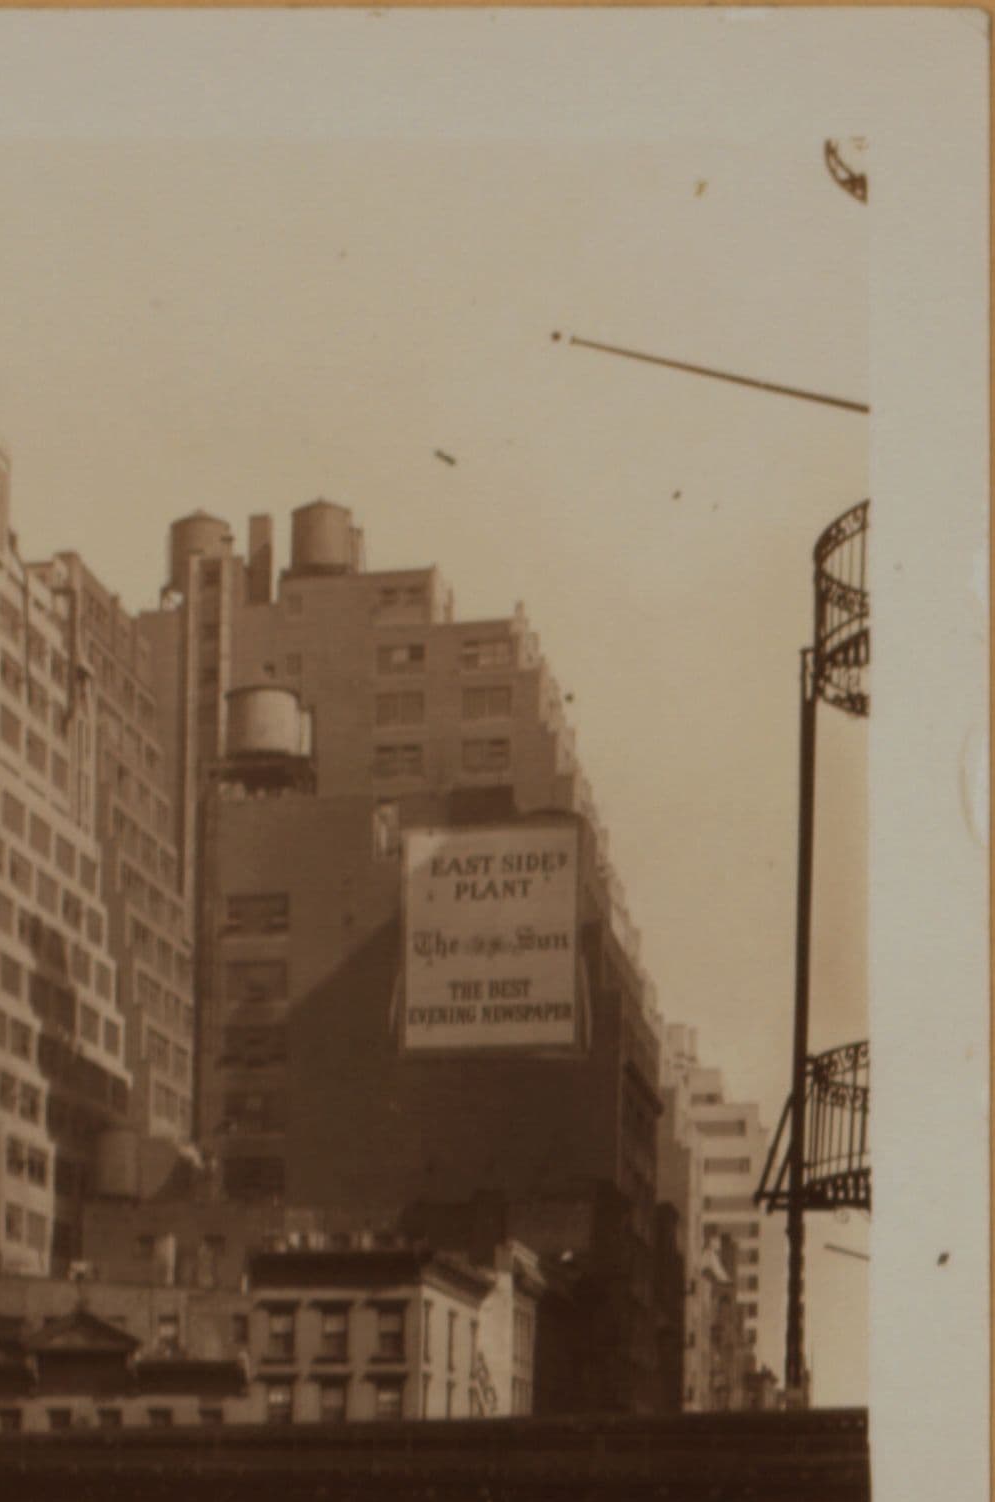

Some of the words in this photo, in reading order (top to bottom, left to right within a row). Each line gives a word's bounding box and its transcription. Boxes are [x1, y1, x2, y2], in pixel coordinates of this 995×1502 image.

[431, 854, 493, 877] EAST
[502, 851, 556, 873] SIDE
[454, 880, 532, 901] PLANT
[413, 929, 458, 958] The
[448, 979, 483, 1000] THE
[489, 978, 531, 999] BEST
[409, 1005, 476, 1025] EVENING
[481, 1002, 573, 1024] NEWSPAPER
